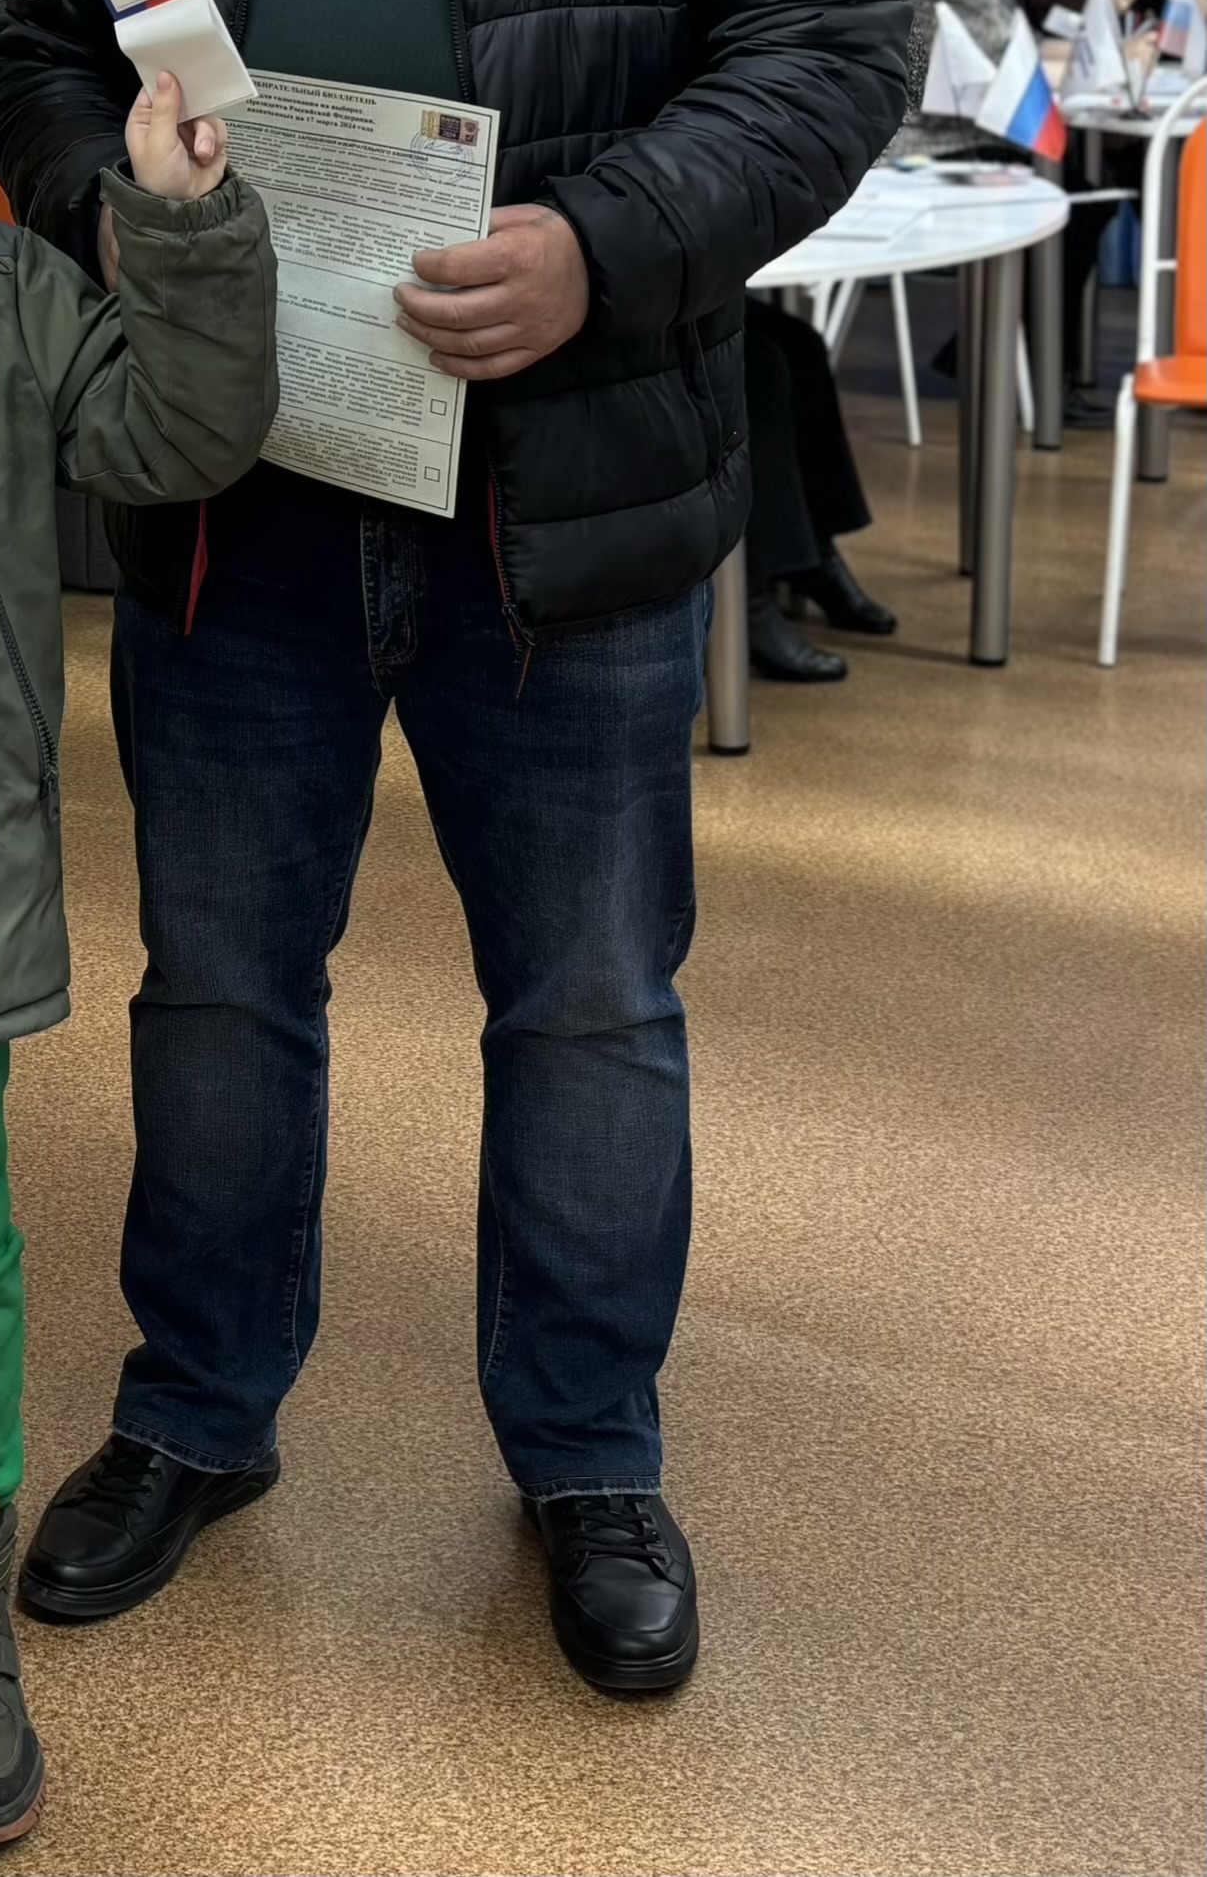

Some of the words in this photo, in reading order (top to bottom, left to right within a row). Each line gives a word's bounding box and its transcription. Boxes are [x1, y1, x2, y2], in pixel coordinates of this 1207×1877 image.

[246, 98, 288, 111] Президента
[289, 106, 331, 118] Российской
[273, 95, 319, 108] голосования
[331, 105, 363, 115] выборах
[322, 91, 377, 105] БЮЛЛЕТЕНЬ
[247, 107, 294, 120] назначенных
[316, 118, 338, 127] марта
[340, 121, 356, 130] 2024
